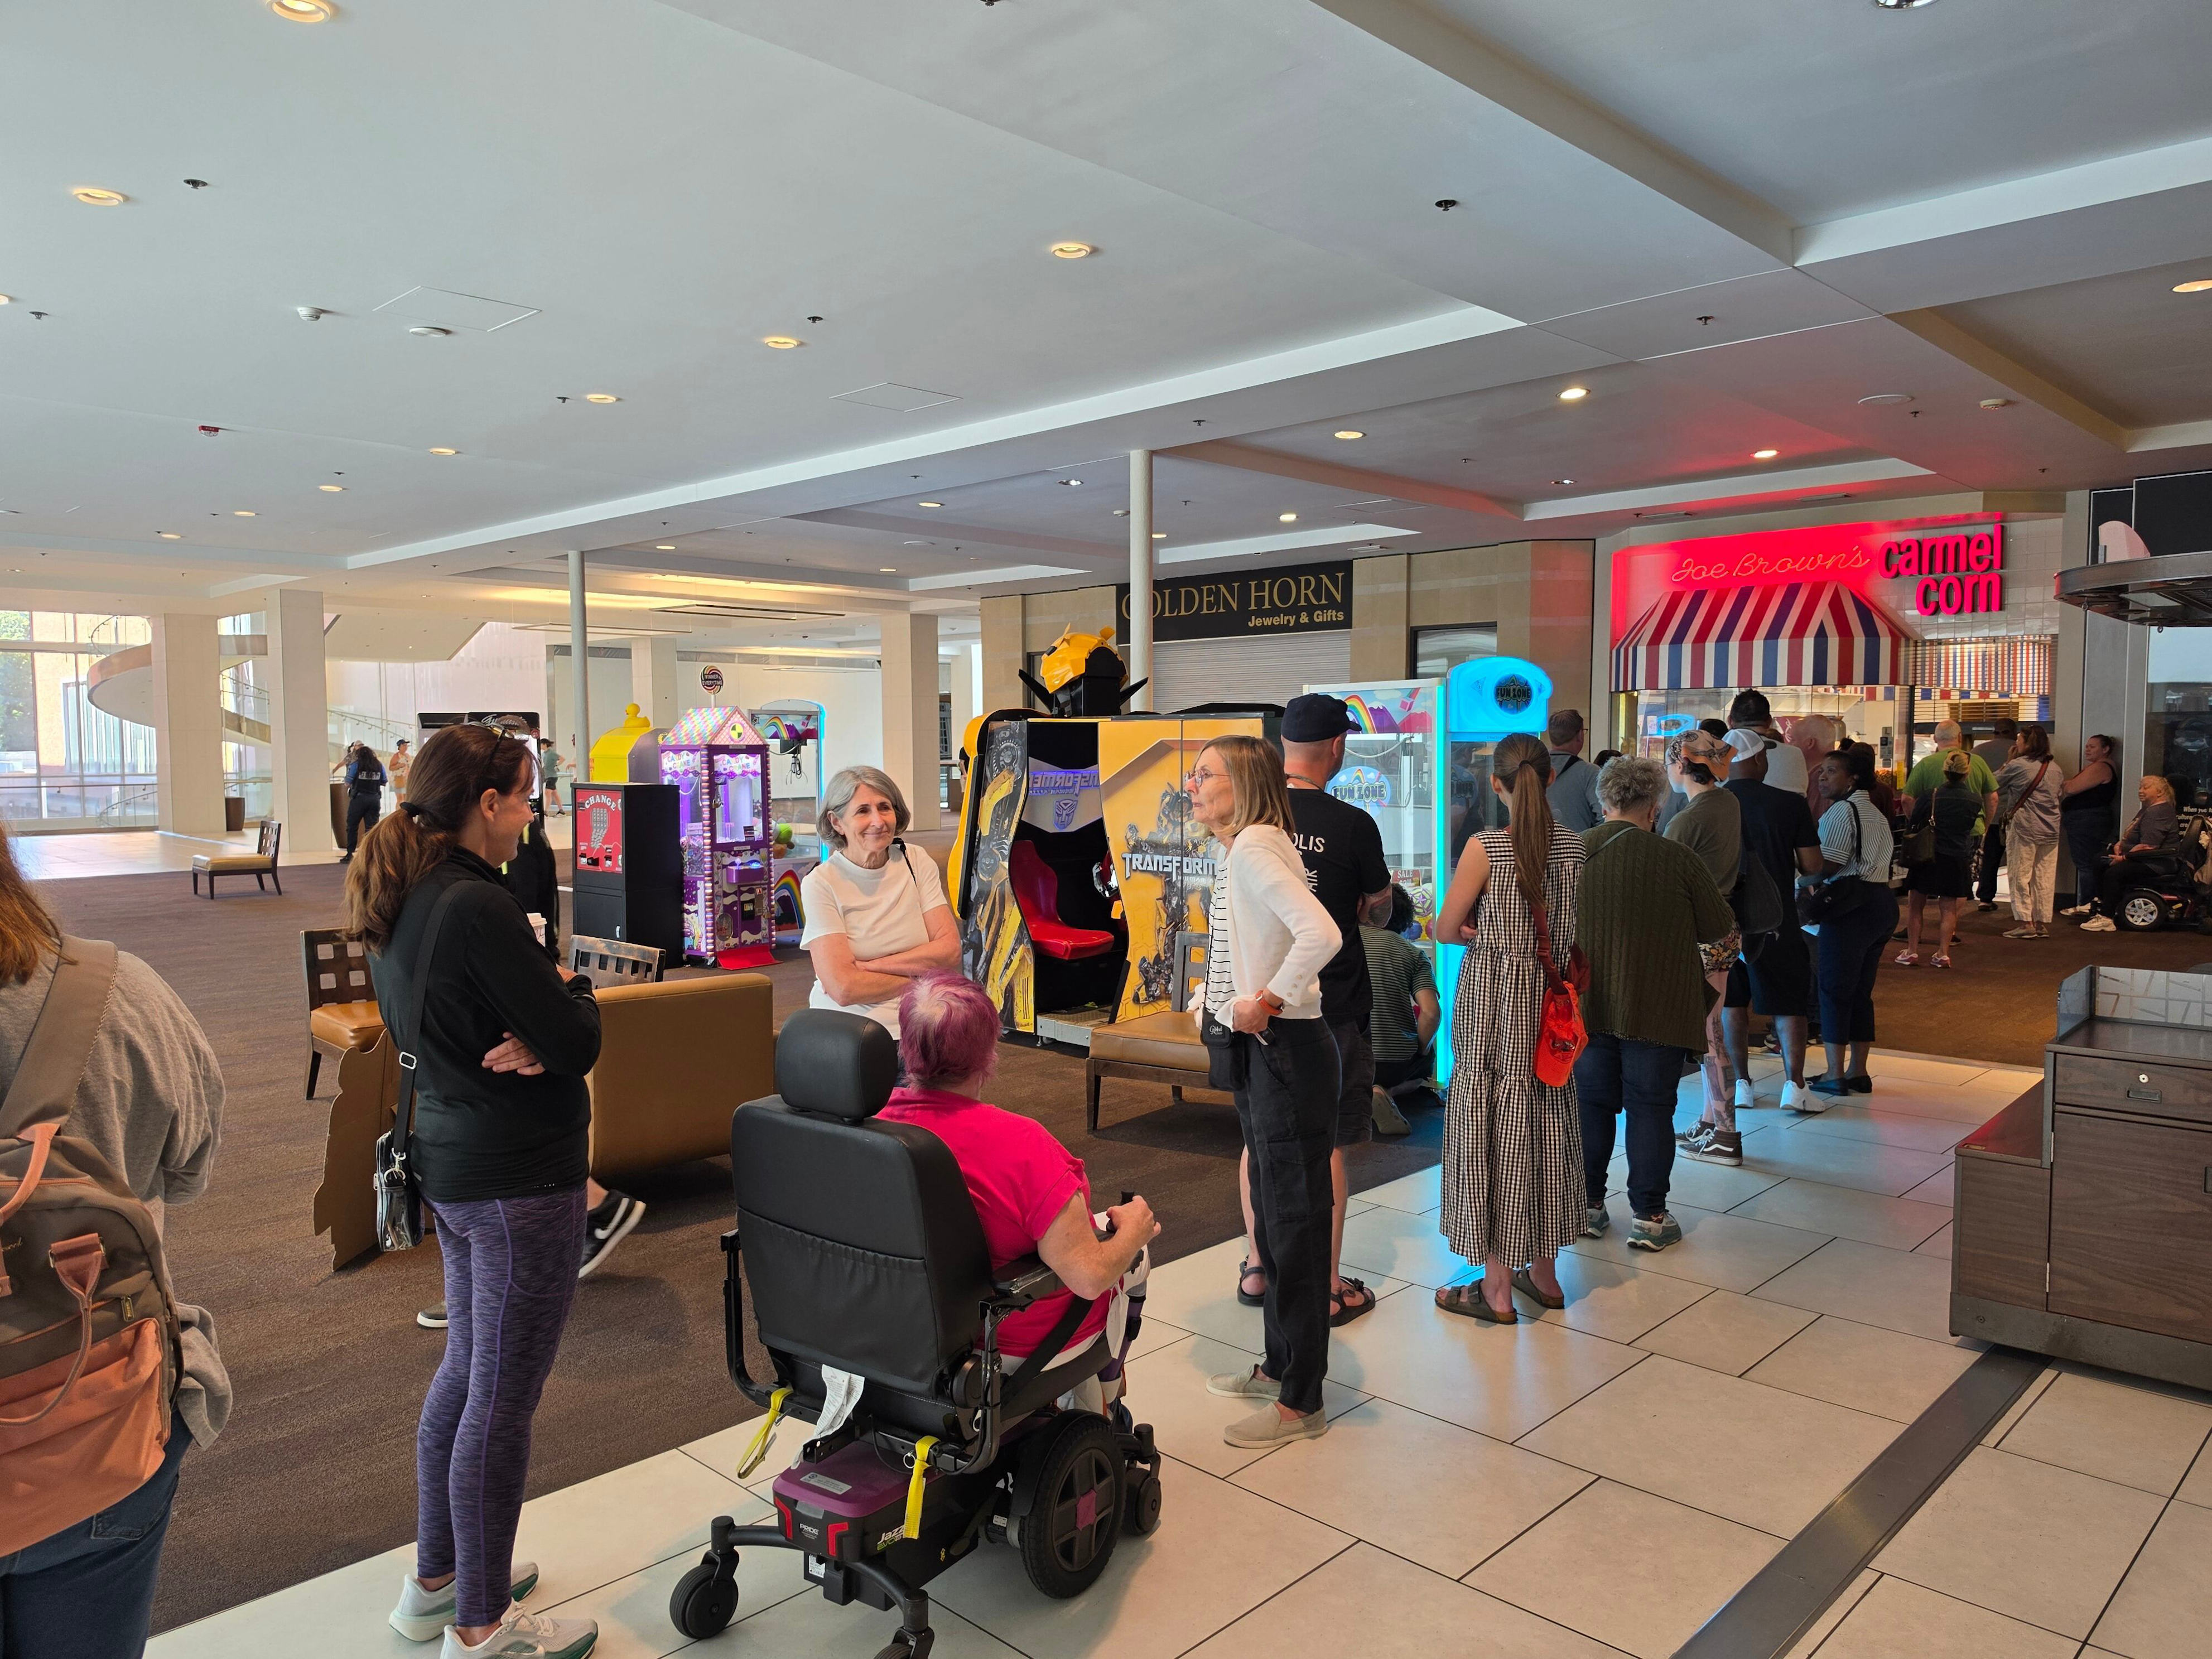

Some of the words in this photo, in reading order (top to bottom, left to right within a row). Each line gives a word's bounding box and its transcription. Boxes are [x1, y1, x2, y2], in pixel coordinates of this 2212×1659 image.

[1878, 524, 2004, 579] carmel
[1671, 558, 1729, 582] Joe
[1732, 545, 1872, 576] Brown's
[1248, 572, 1346, 610] HORN
[1915, 572, 2004, 616] corn
[1248, 613, 1296, 627] Jewelry
[1299, 611, 1309, 623] &
[1313, 610, 1344, 623] Gifts
[1496, 686, 1511, 698] FUN
[1512, 686, 1531, 698] ZONE
[722, 755, 744, 765] CANDY
[1332, 785, 1355, 801] FUN
[1356, 783, 1385, 800] ZONE
[585, 794, 617, 811] CHANGE
[1121, 852, 1218, 881] TRANSFORM
[1397, 869, 1413, 879] SALE
[799, 1523, 820, 1535] PRIDE
